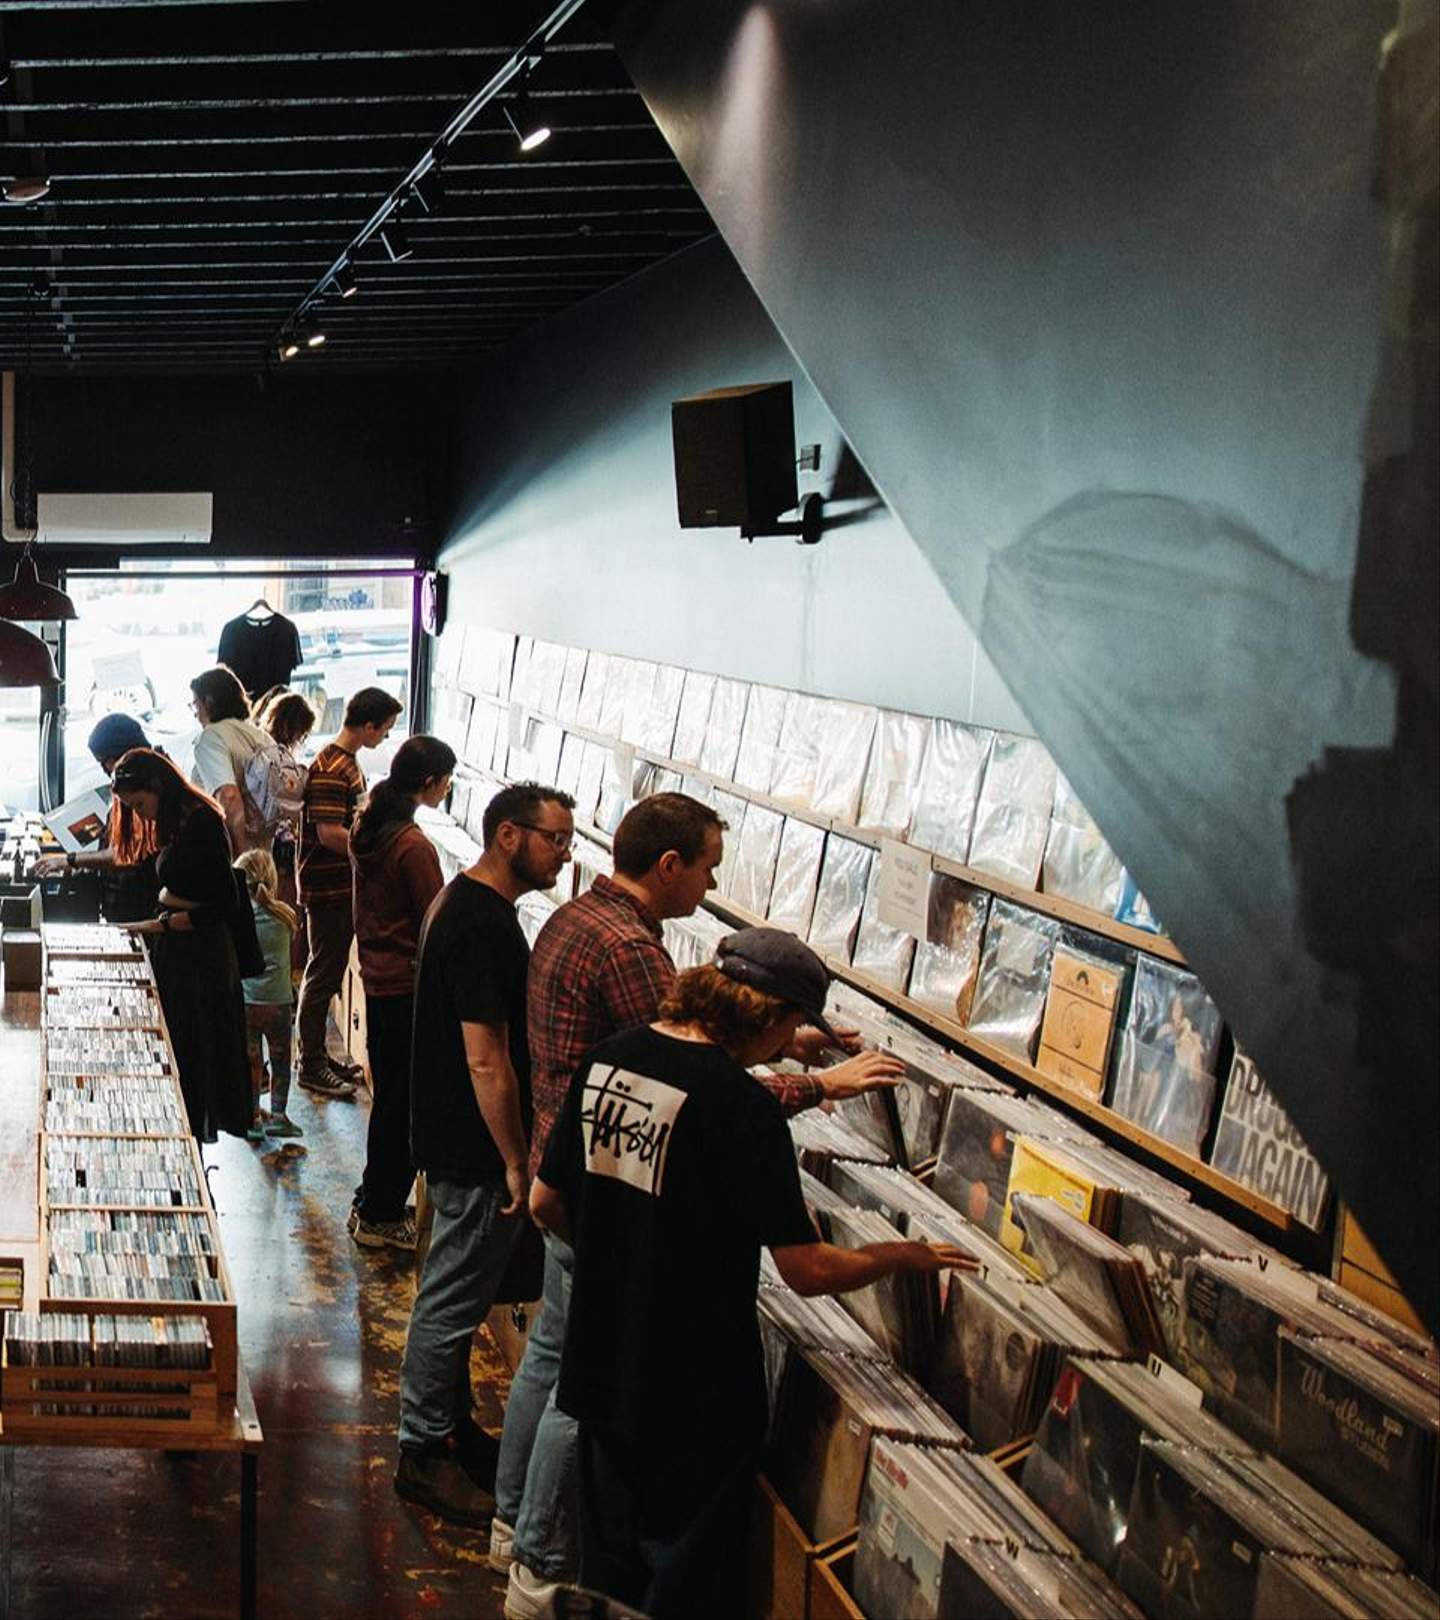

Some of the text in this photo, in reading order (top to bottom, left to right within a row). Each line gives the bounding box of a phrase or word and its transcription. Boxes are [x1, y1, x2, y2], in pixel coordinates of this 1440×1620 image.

[1237, 1131, 1328, 1228] AGAIN
[1257, 1254, 1269, 1272] V
[1151, 1358, 1162, 1378] U
[1005, 1536, 1019, 1560] W
